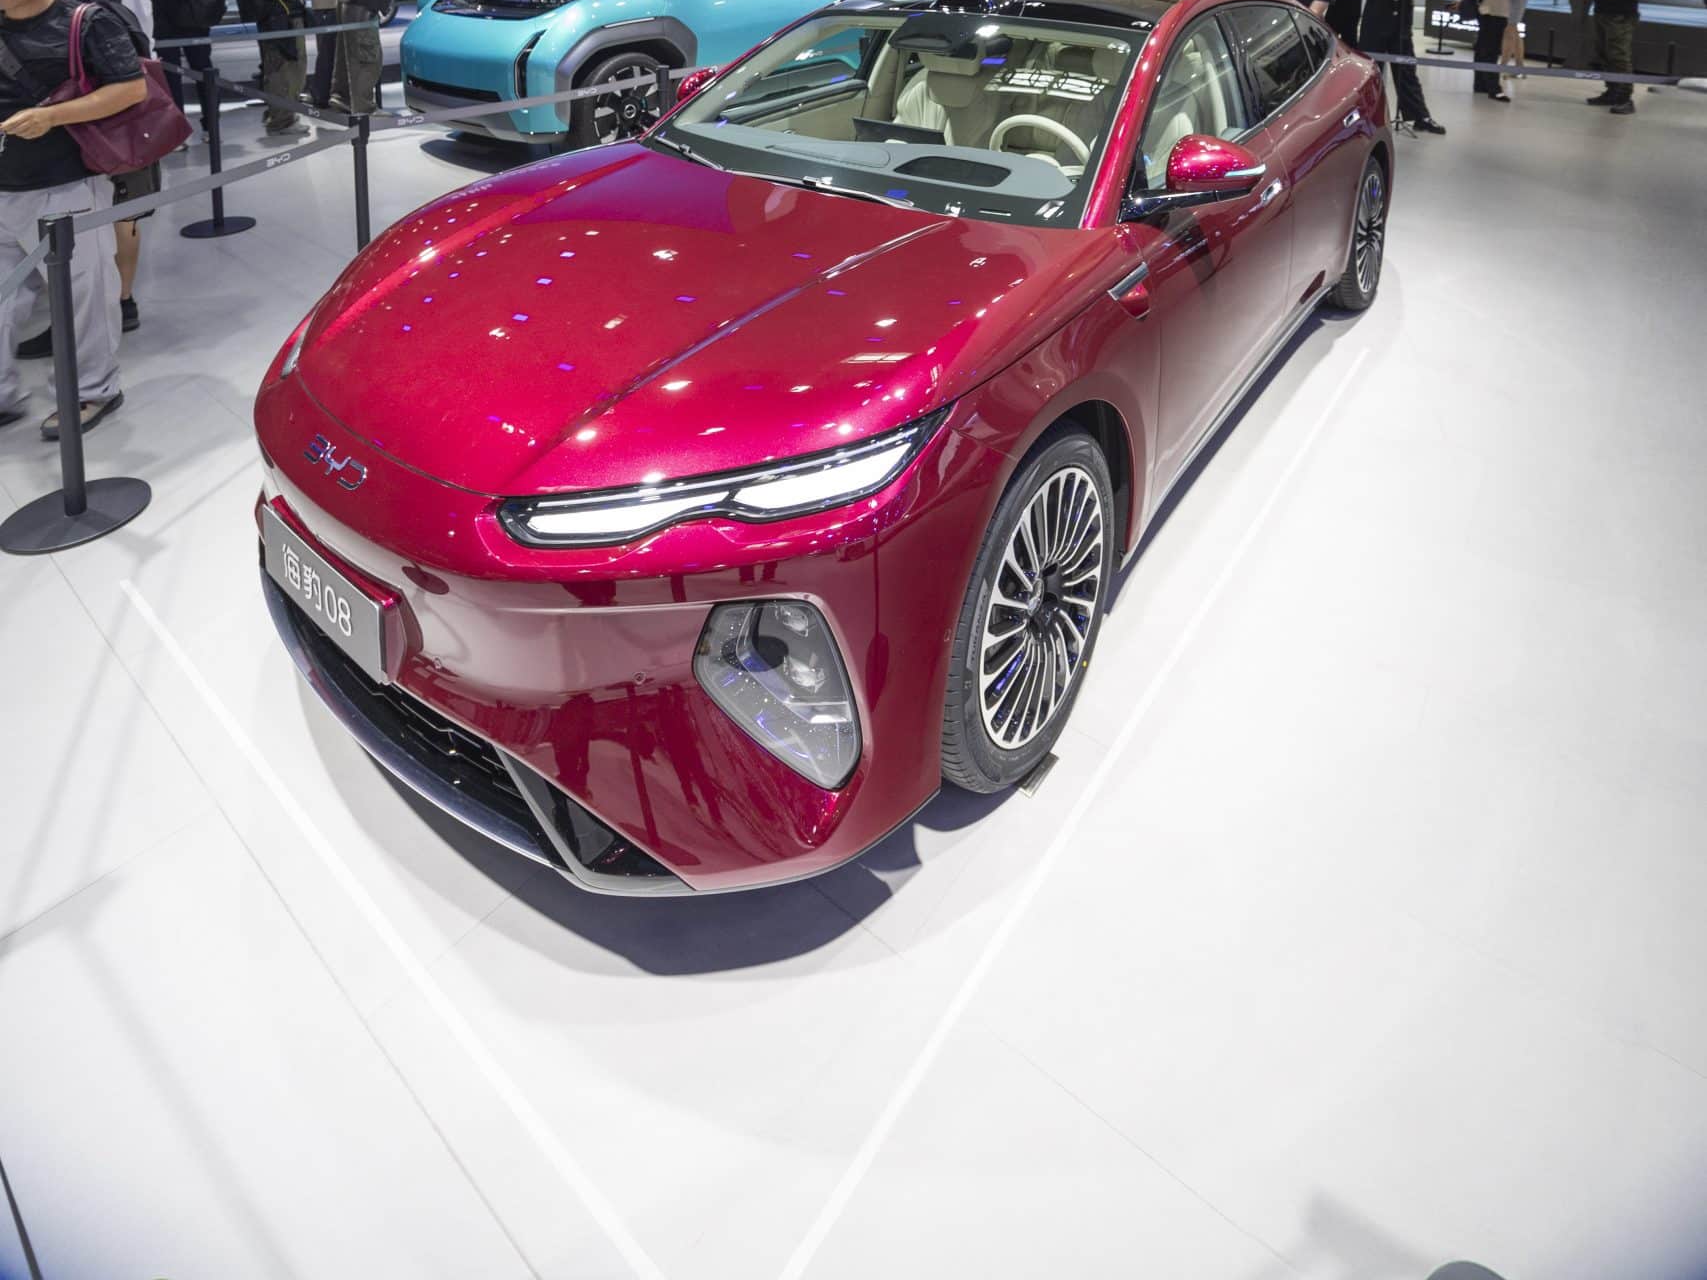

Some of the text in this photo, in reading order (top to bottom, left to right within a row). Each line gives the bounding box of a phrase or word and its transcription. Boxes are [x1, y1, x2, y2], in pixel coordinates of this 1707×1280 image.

[577, 86, 598, 97] BYD
[397, 115, 425, 126] BYD
[266, 152, 291, 168] BYD
[303, 433, 368, 491] BYD
[282, 543, 352, 637] 海豹08
